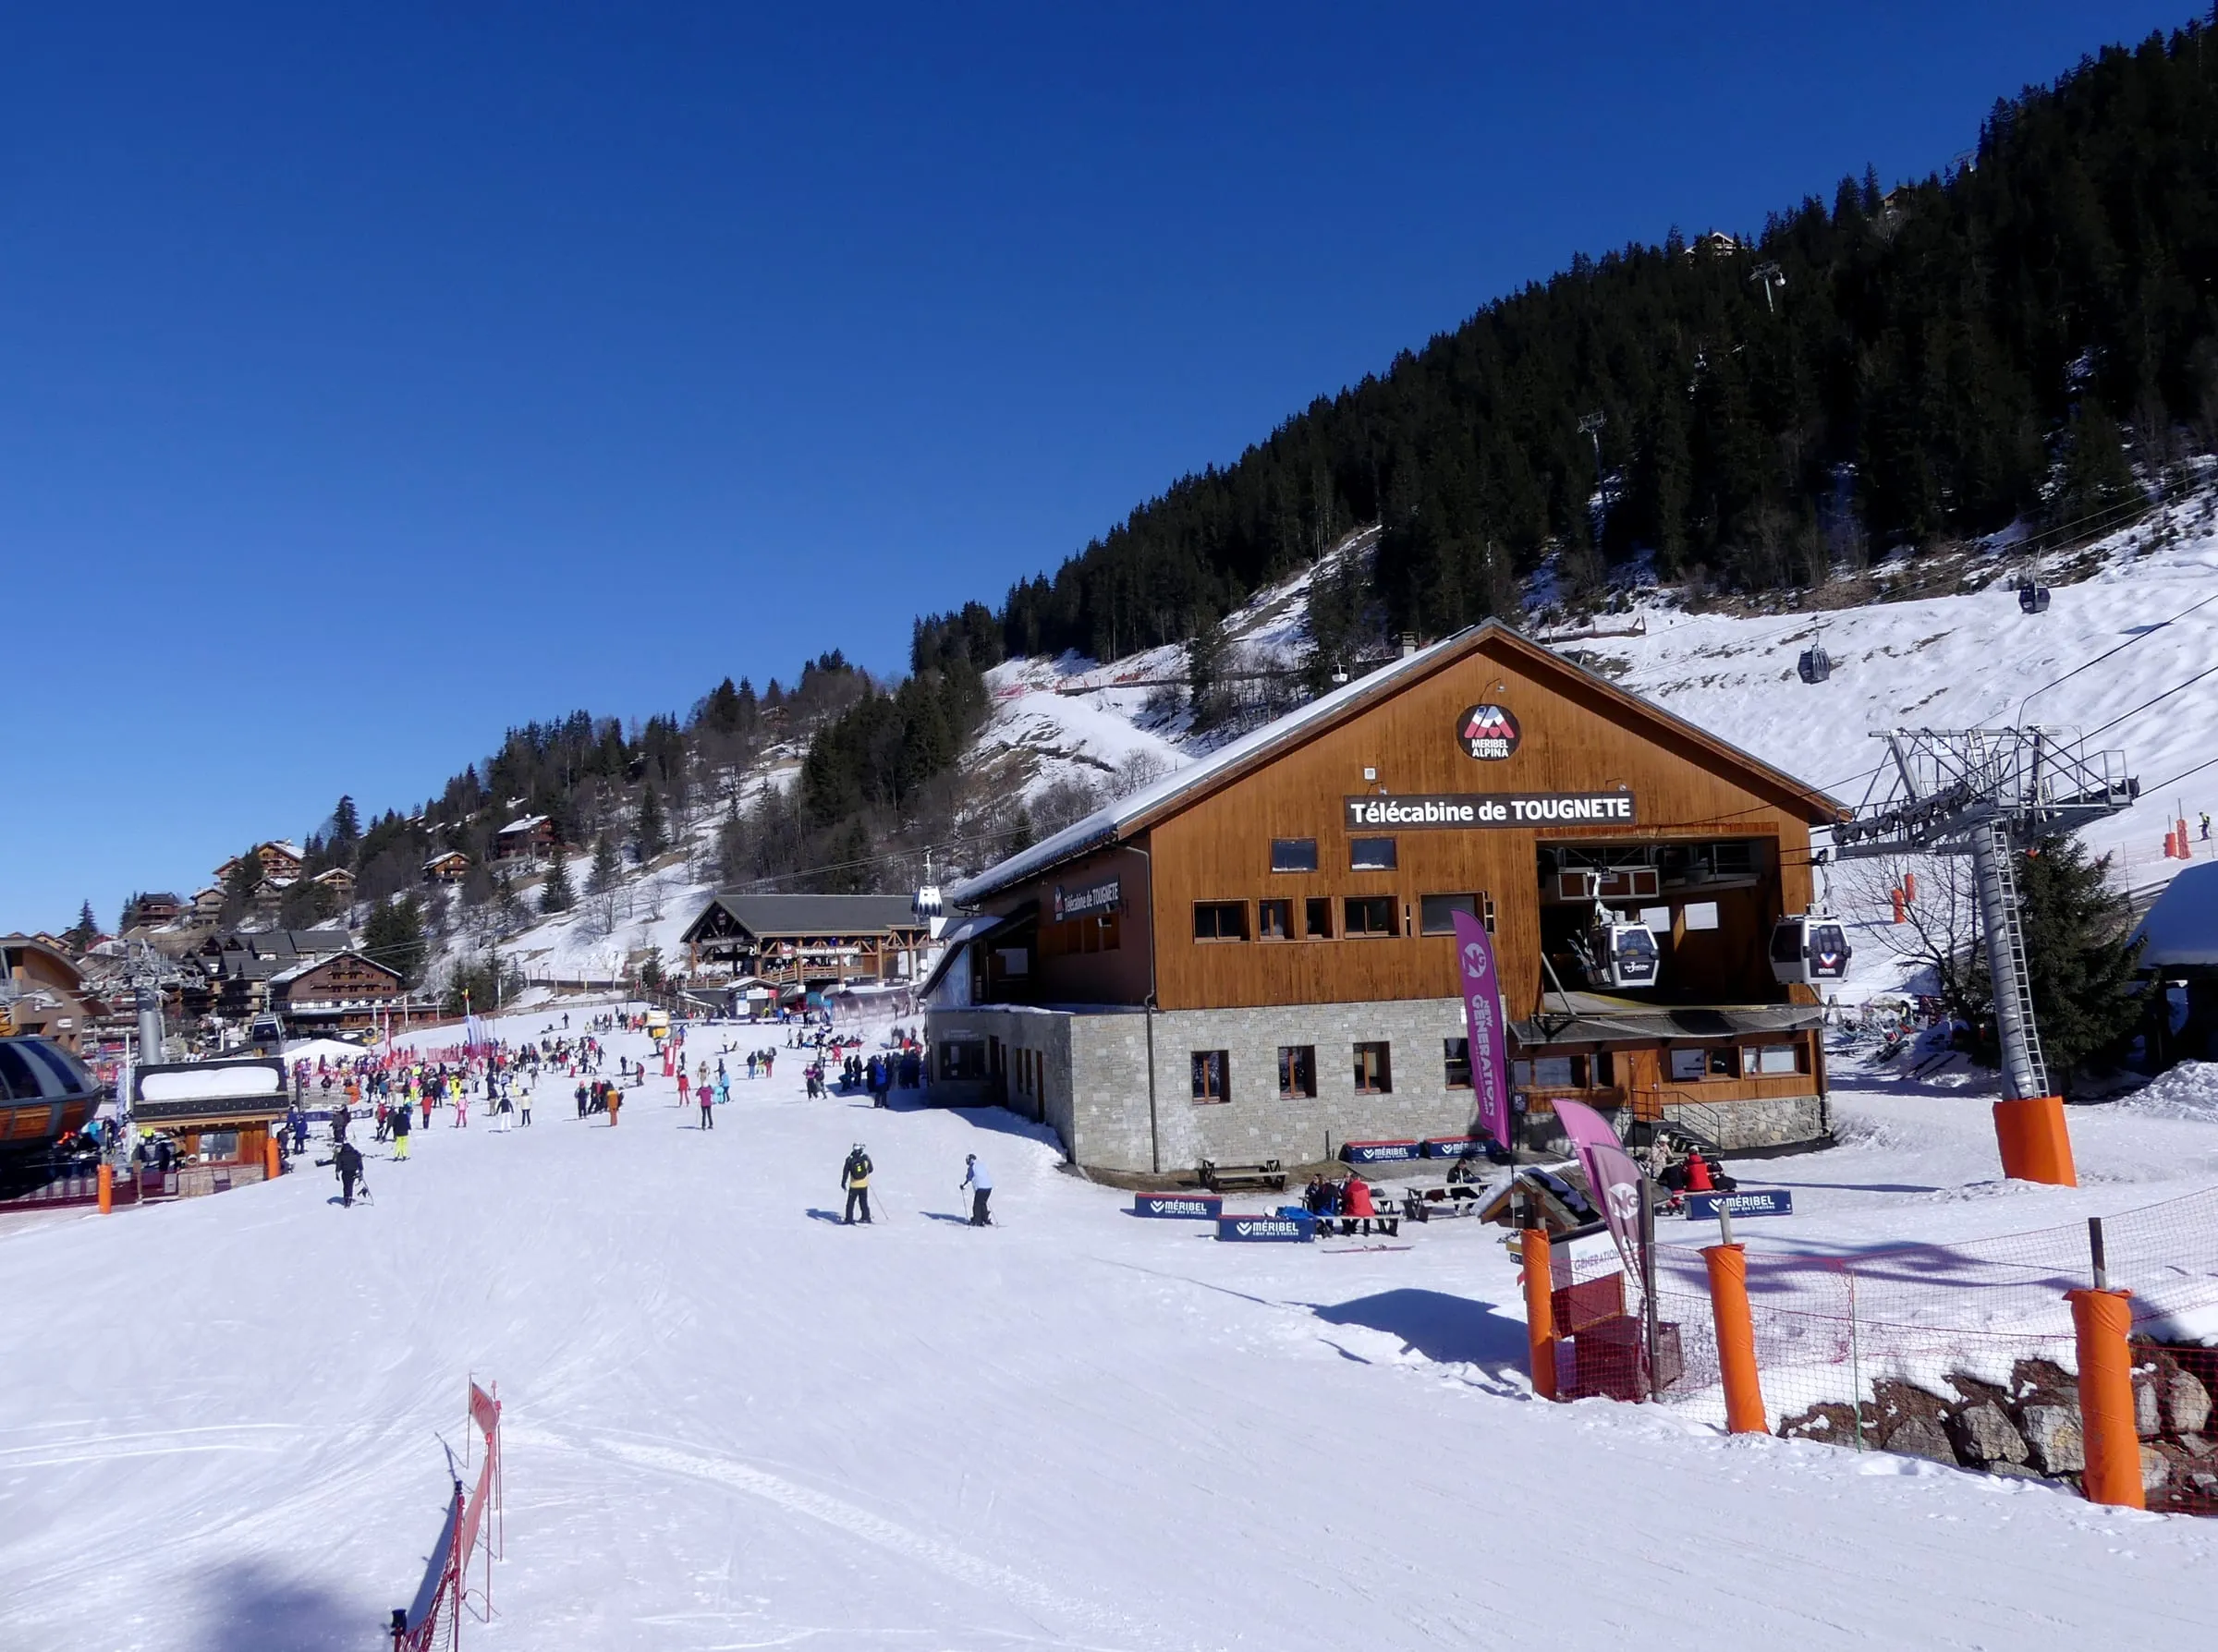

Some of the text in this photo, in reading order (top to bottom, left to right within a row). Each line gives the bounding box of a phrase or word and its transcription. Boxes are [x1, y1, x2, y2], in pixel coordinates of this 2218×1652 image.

[1471, 739, 1508, 748] MERIBEL
[1472, 748, 1508, 758] ALPINA
[1350, 797, 1630, 823] Télécabine de TOUGNETE
[1086, 890, 1093, 907] de
[1091, 881, 1118, 905] TOUGNETE
[1482, 1000, 1493, 1028] NEW
[1471, 994, 1494, 1116] GENERATION
[1375, 1146, 1408, 1157] MÉRIBEL
[1164, 1199, 1207, 1211] MÉRIBEL
[1726, 1195, 1774, 1208] MÉRIBEL
[1252, 1220, 1299, 1232] MÉRIBEL
